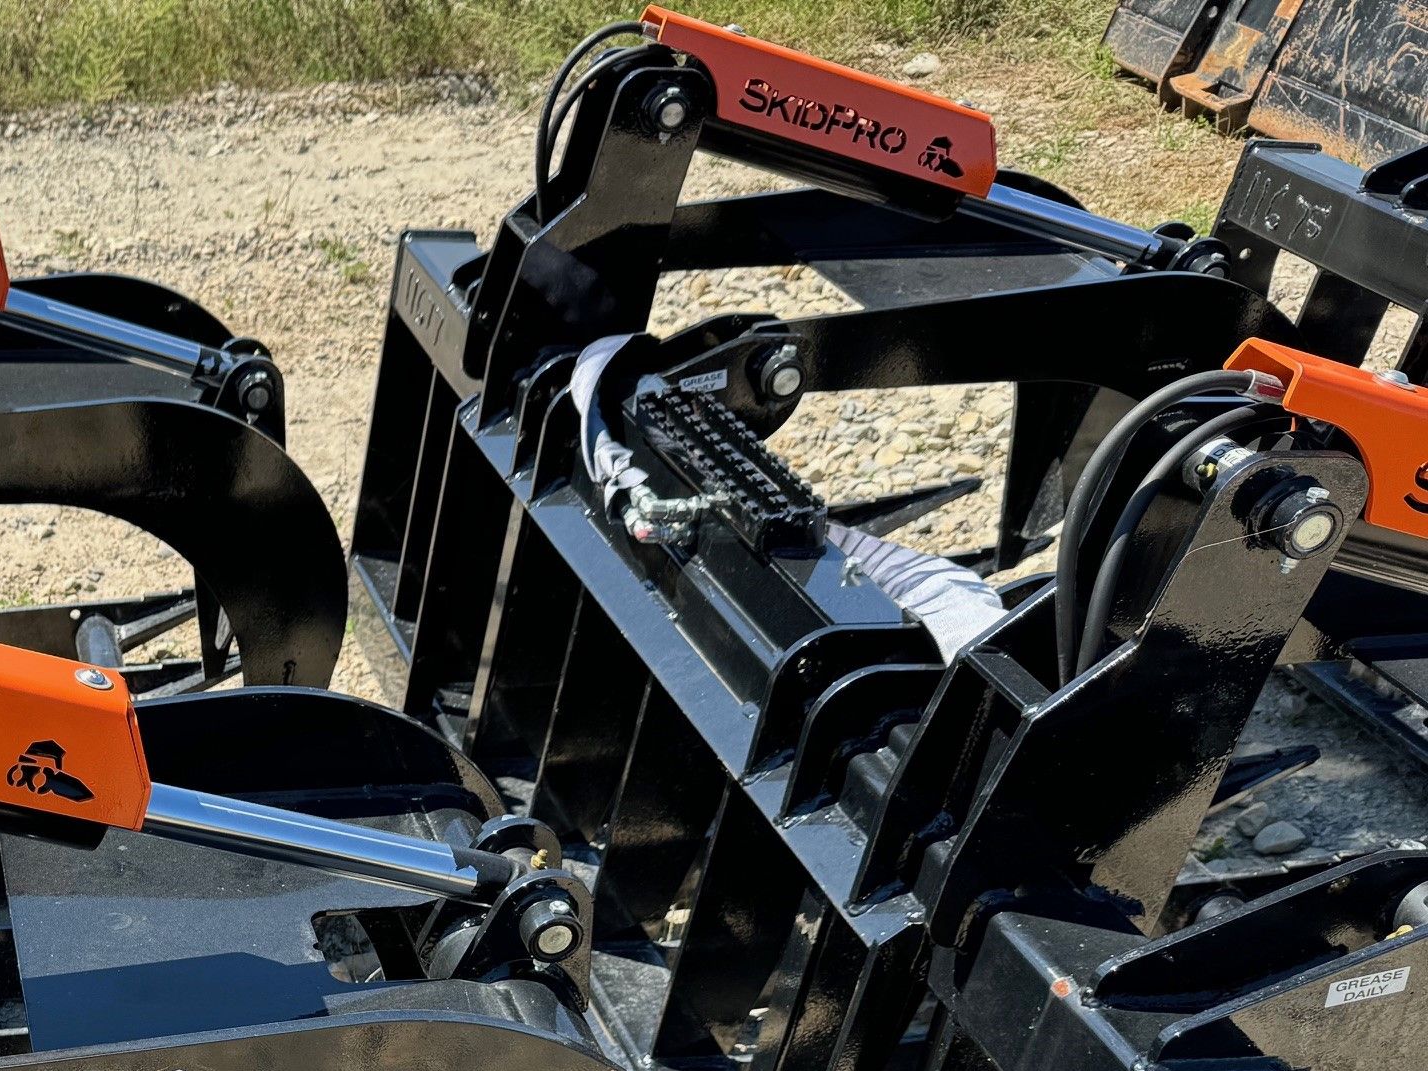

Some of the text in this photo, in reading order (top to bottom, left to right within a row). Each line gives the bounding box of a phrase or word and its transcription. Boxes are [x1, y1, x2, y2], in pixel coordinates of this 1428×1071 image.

[683, 372, 724, 388] GREASE
[1336, 969, 1405, 992] GREASE
[1343, 984, 1390, 1002] DAILY
